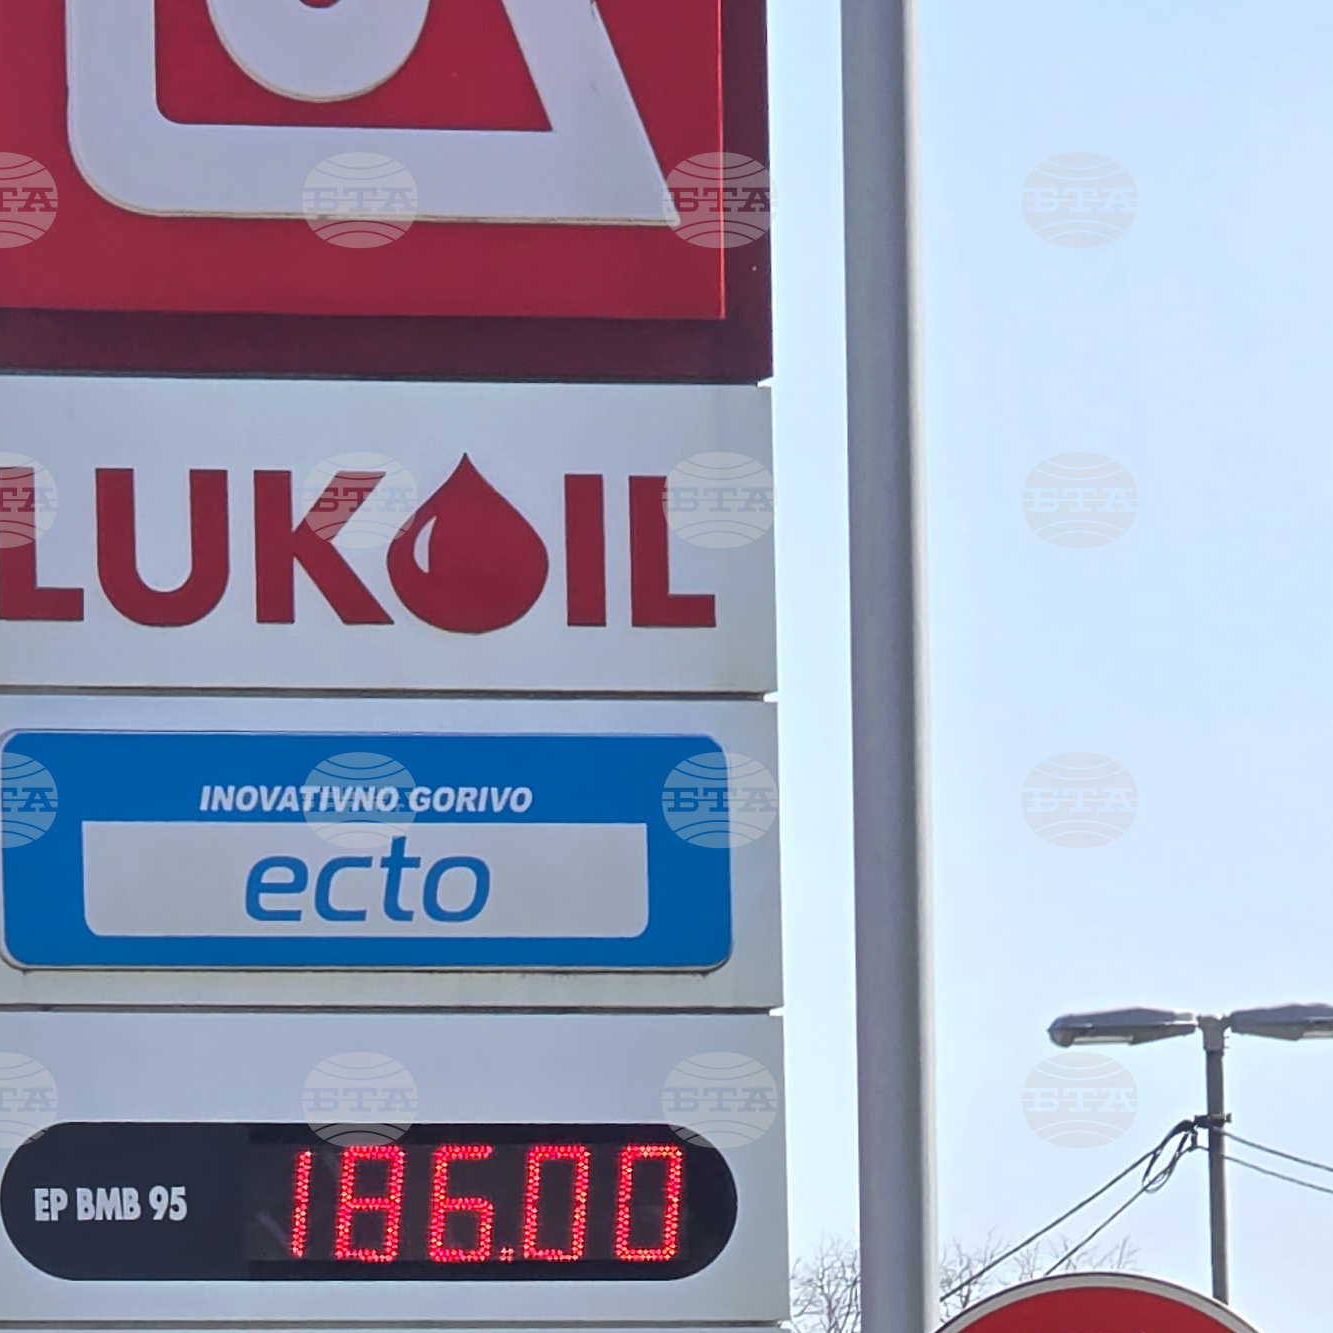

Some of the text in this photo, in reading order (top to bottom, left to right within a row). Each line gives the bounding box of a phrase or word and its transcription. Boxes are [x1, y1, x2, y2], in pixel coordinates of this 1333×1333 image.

[199, 785, 533, 813] INOVATIVNO GORIVO
[244, 835, 491, 922] ecto
[34, 1185, 188, 1222] EP BMB 95
[290, 1144, 684, 1263] 186.00
